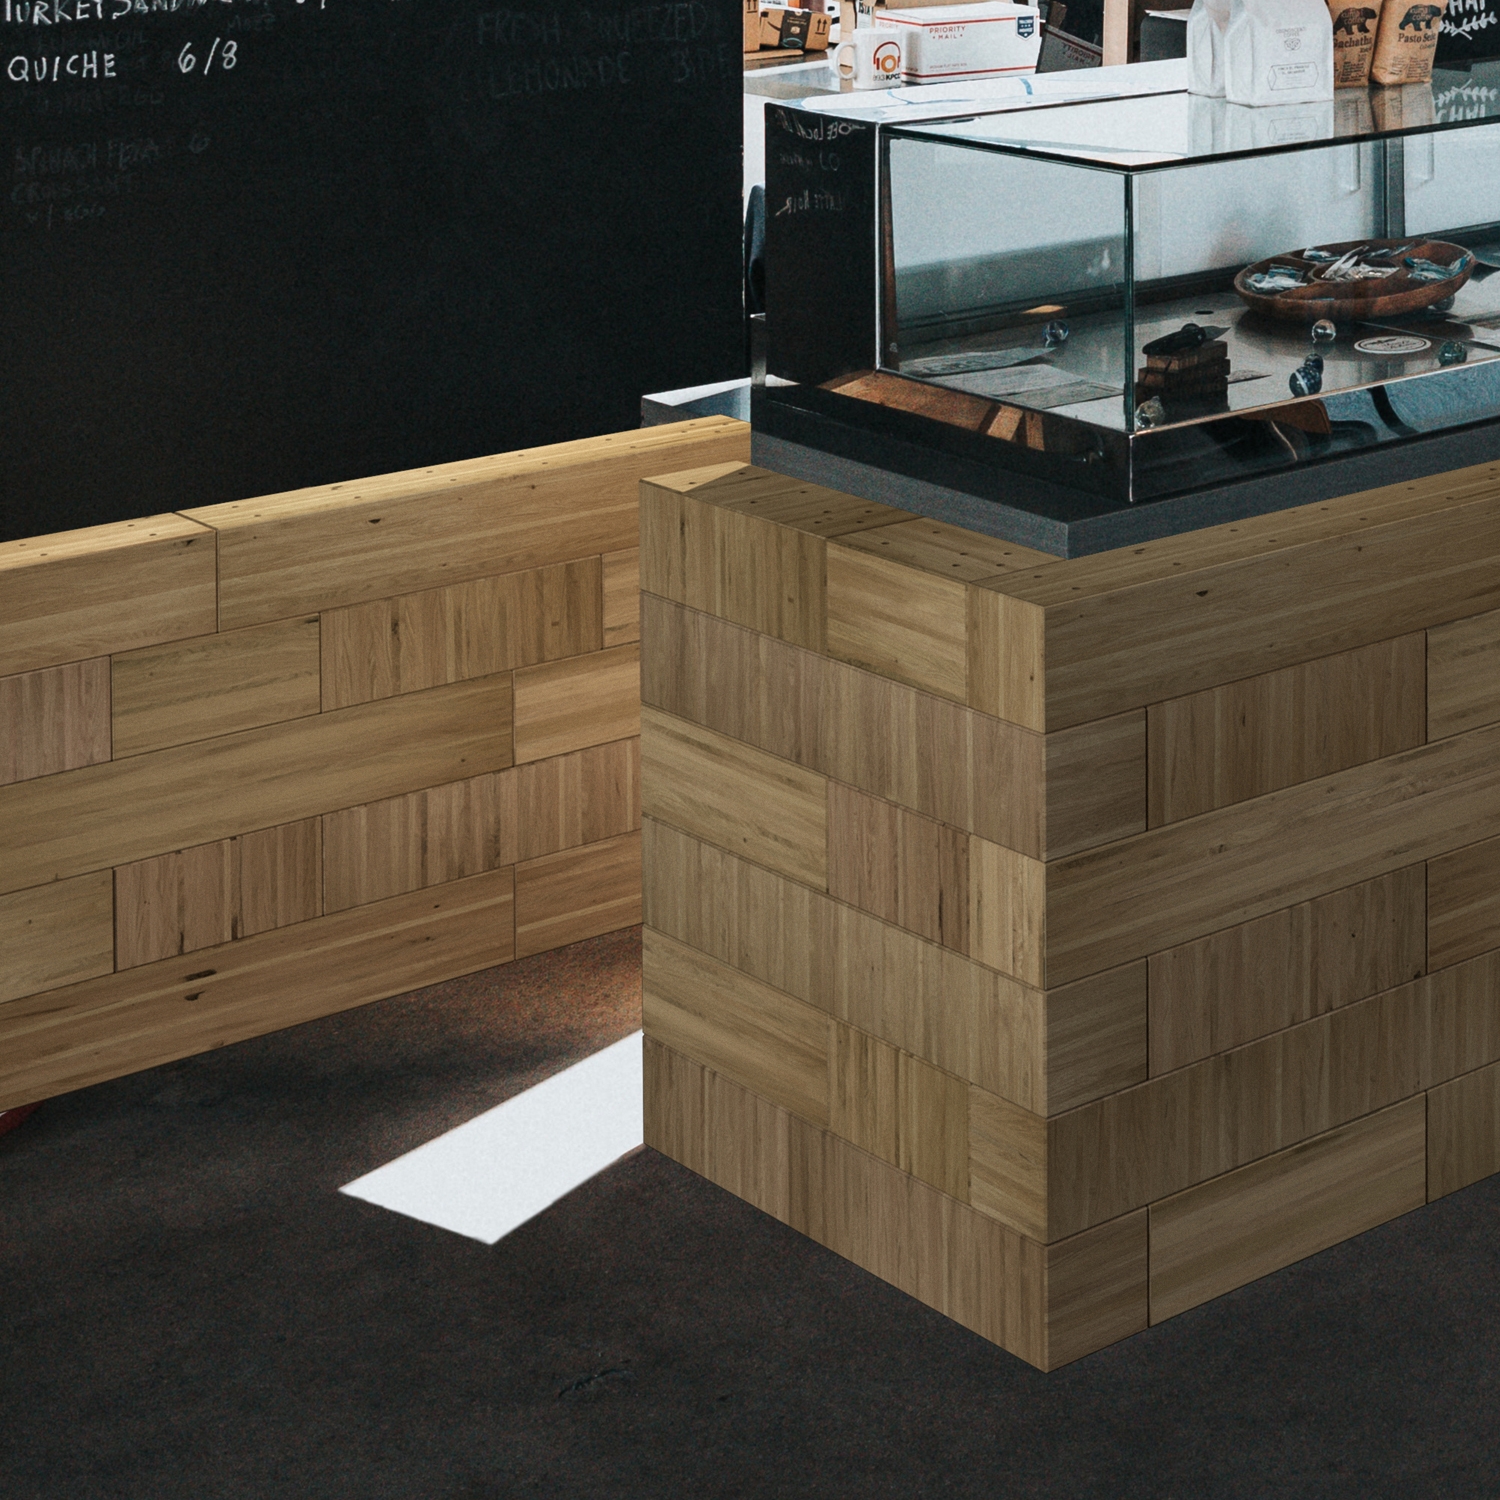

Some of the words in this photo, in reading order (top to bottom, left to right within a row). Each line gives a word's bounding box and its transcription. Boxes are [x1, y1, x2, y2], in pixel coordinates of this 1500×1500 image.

[929, 25, 966, 34] PRIORITY
[1398, 32, 1421, 45] Pasto
[7, 53, 117, 82] QUICHE
[177, 37, 238, 76] 6/8
